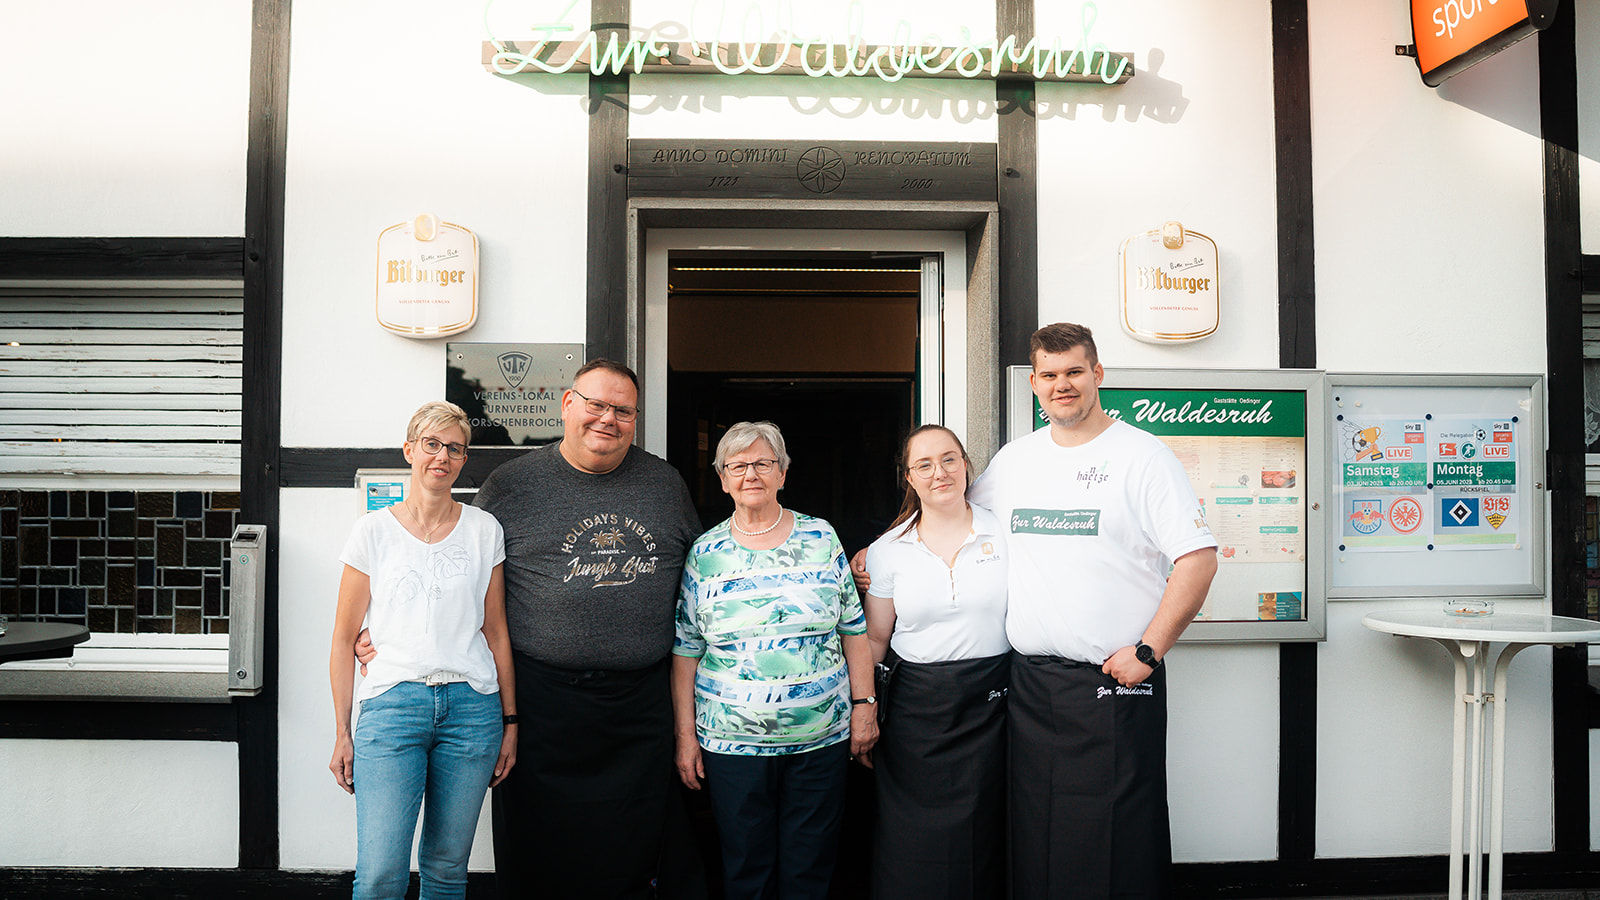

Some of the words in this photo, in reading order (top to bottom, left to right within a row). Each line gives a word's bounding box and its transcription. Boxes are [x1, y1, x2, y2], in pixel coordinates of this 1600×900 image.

[1433, 0, 1499, 39] spo
[691, 0, 1128, 84] Waldesruh
[652, 149, 707, 163] ANNO
[715, 149, 788, 163] DOMINI
[854, 151, 972, 167] RENOVATUM
[901, 178, 934, 190] 2000
[386, 259, 466, 287] Bitburger
[1136, 266, 1211, 294] Bitburger
[482, 405, 547, 414] TURNVEREIN
[1132, 398, 1273, 424] Waldesruh
[1387, 449, 1411, 457] LIVE
[1485, 447, 1508, 456] LIVE
[1347, 465, 1400, 478] Samstag
[1437, 464, 1484, 478] Montag
[1484, 497, 1509, 511] VfB
[1012, 514, 1029, 531] Zur
[1032, 515, 1096, 530] Waldesruh
[561, 513, 619, 554] HOLIDAYS
[624, 516, 657, 552] VIBES
[563, 556, 618, 583] Jungle
[1097, 686, 1112, 699] Zur
[1115, 686, 1153, 696] Waldesruh
